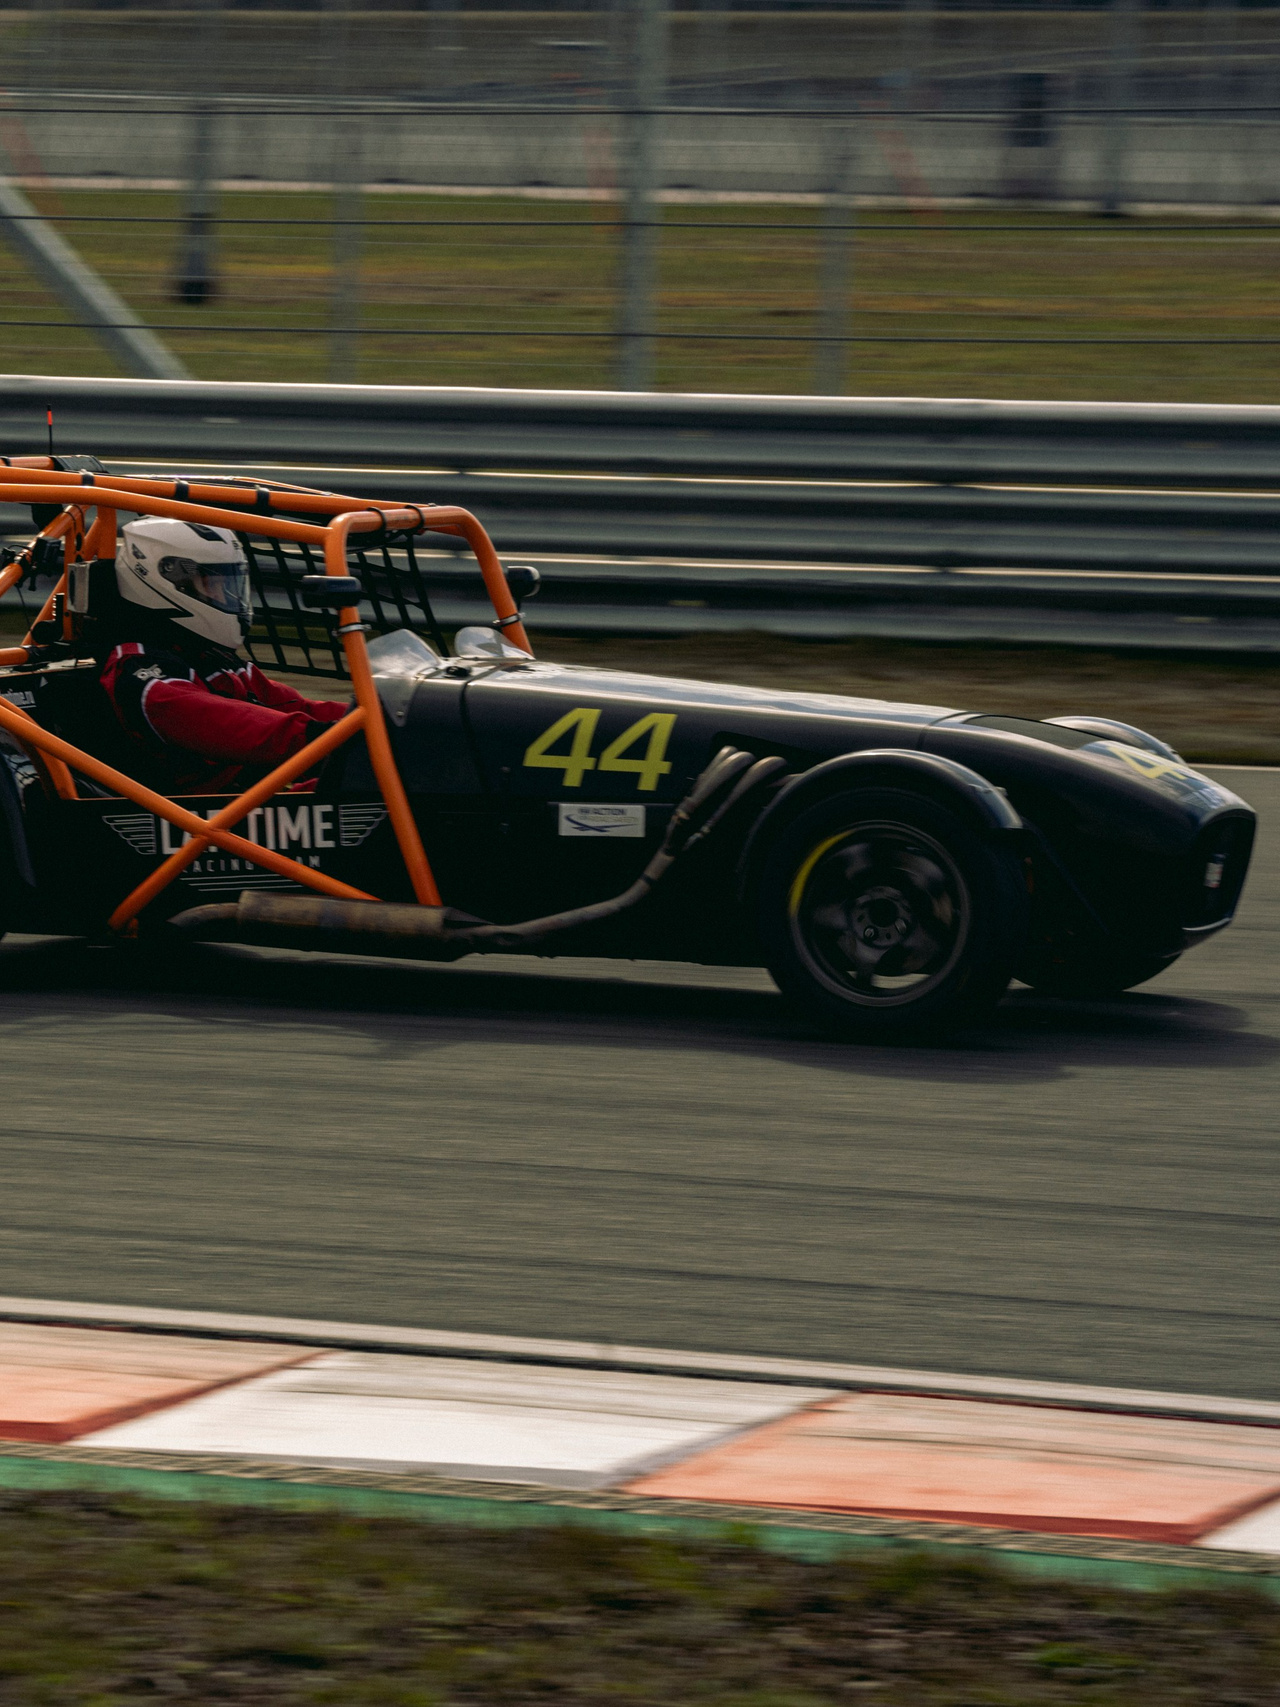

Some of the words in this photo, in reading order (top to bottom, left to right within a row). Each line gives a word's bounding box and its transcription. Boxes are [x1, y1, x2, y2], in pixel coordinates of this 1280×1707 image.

[522, 707, 678, 791] 44
[246, 804, 336, 850] TIME
[182, 857, 255, 874] ACING
